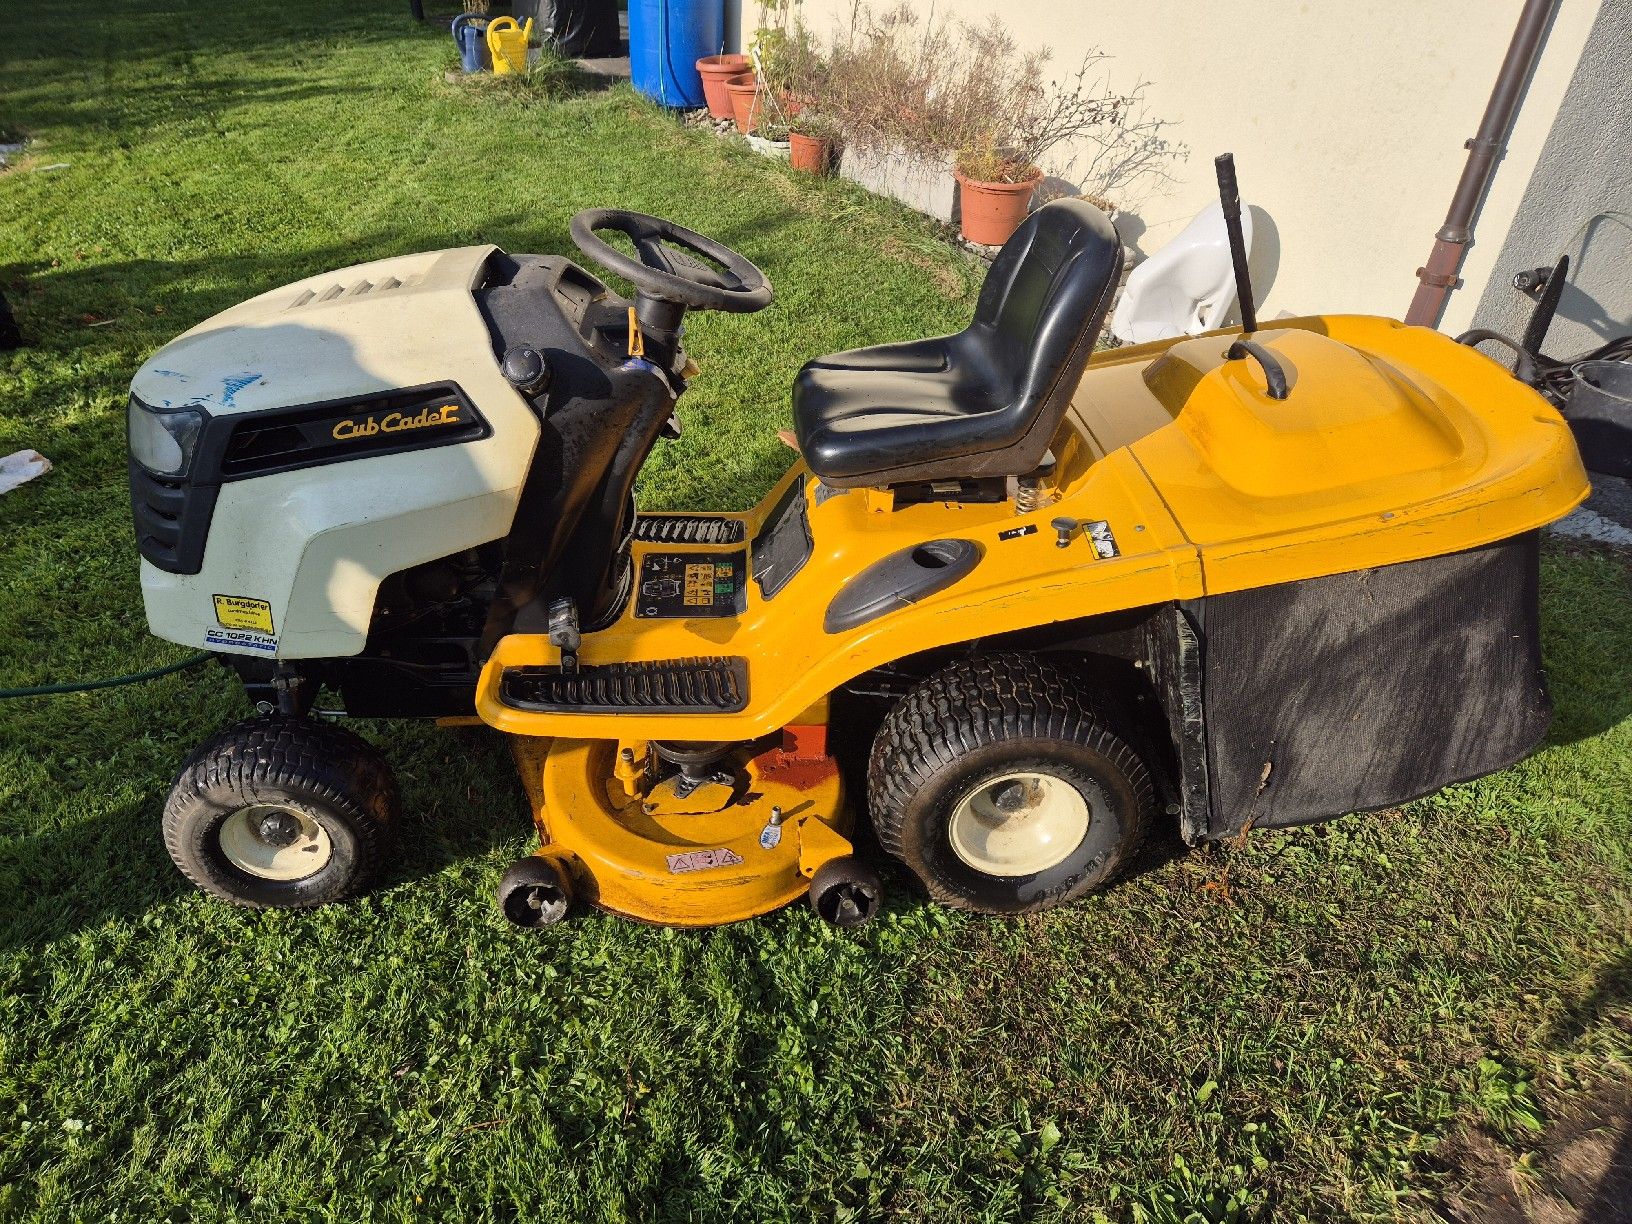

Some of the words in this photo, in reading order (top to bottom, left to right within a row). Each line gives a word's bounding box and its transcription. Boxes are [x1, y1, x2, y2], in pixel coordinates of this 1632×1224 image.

[333, 416, 379, 439] Cub
[381, 405, 460, 432] Cadet
[226, 632, 252, 640] 1022
[254, 635, 277, 645] KHN
